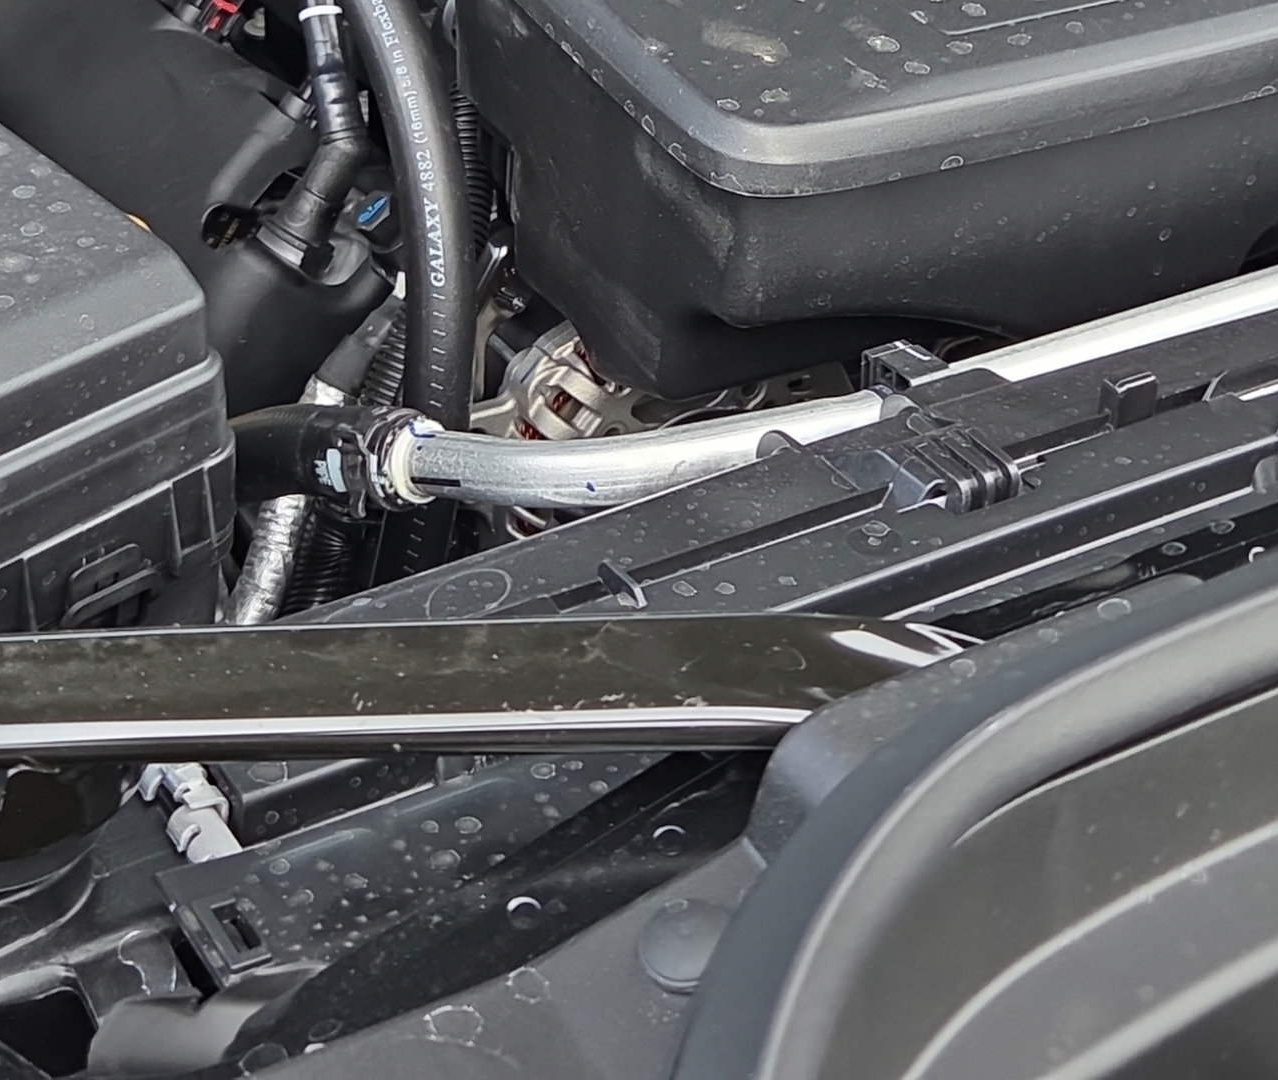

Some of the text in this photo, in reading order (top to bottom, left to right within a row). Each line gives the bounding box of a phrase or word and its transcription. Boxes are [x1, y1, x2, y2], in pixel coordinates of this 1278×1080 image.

[402, 91, 429, 144] (16mm)
[416, 149, 436, 192] 4882
[423, 197, 446, 287] GALAXY
